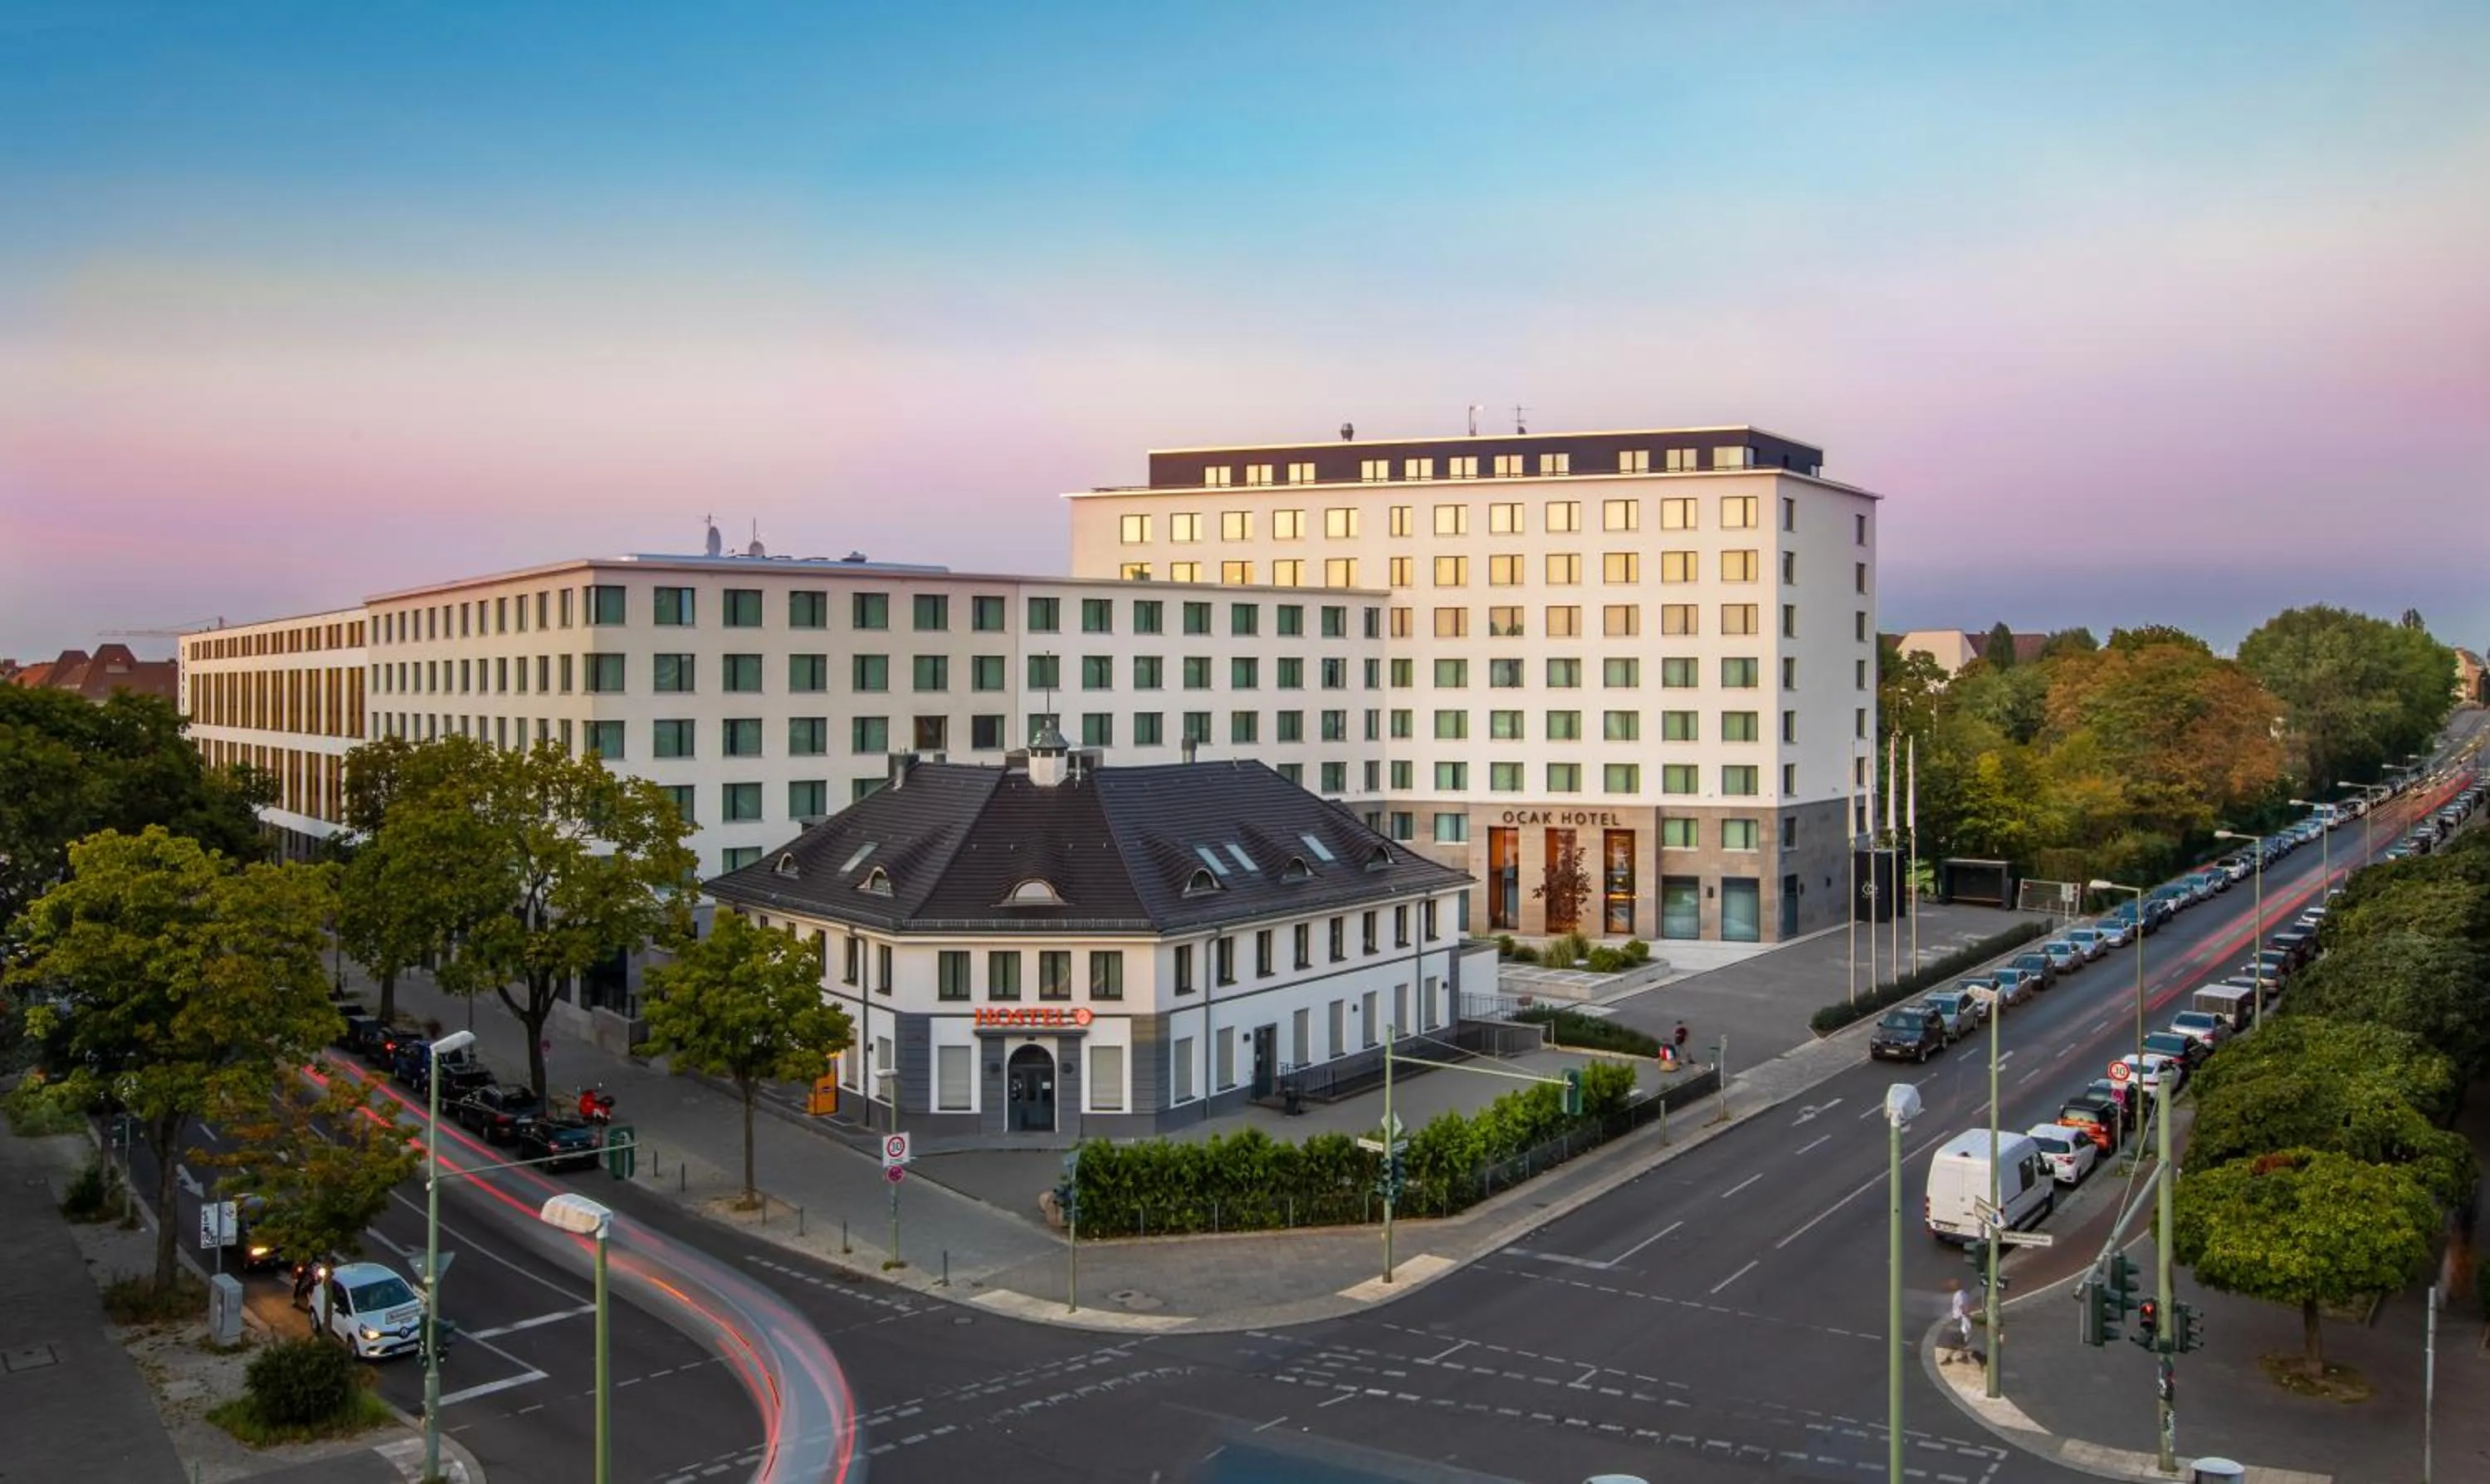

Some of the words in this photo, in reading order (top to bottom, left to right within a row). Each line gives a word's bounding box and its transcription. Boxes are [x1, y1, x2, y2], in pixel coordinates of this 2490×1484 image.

[1502, 811, 1552, 824] OCAK
[1561, 812, 1621, 826] HOTEL
[974, 1008, 1070, 1027] HOSTEL
